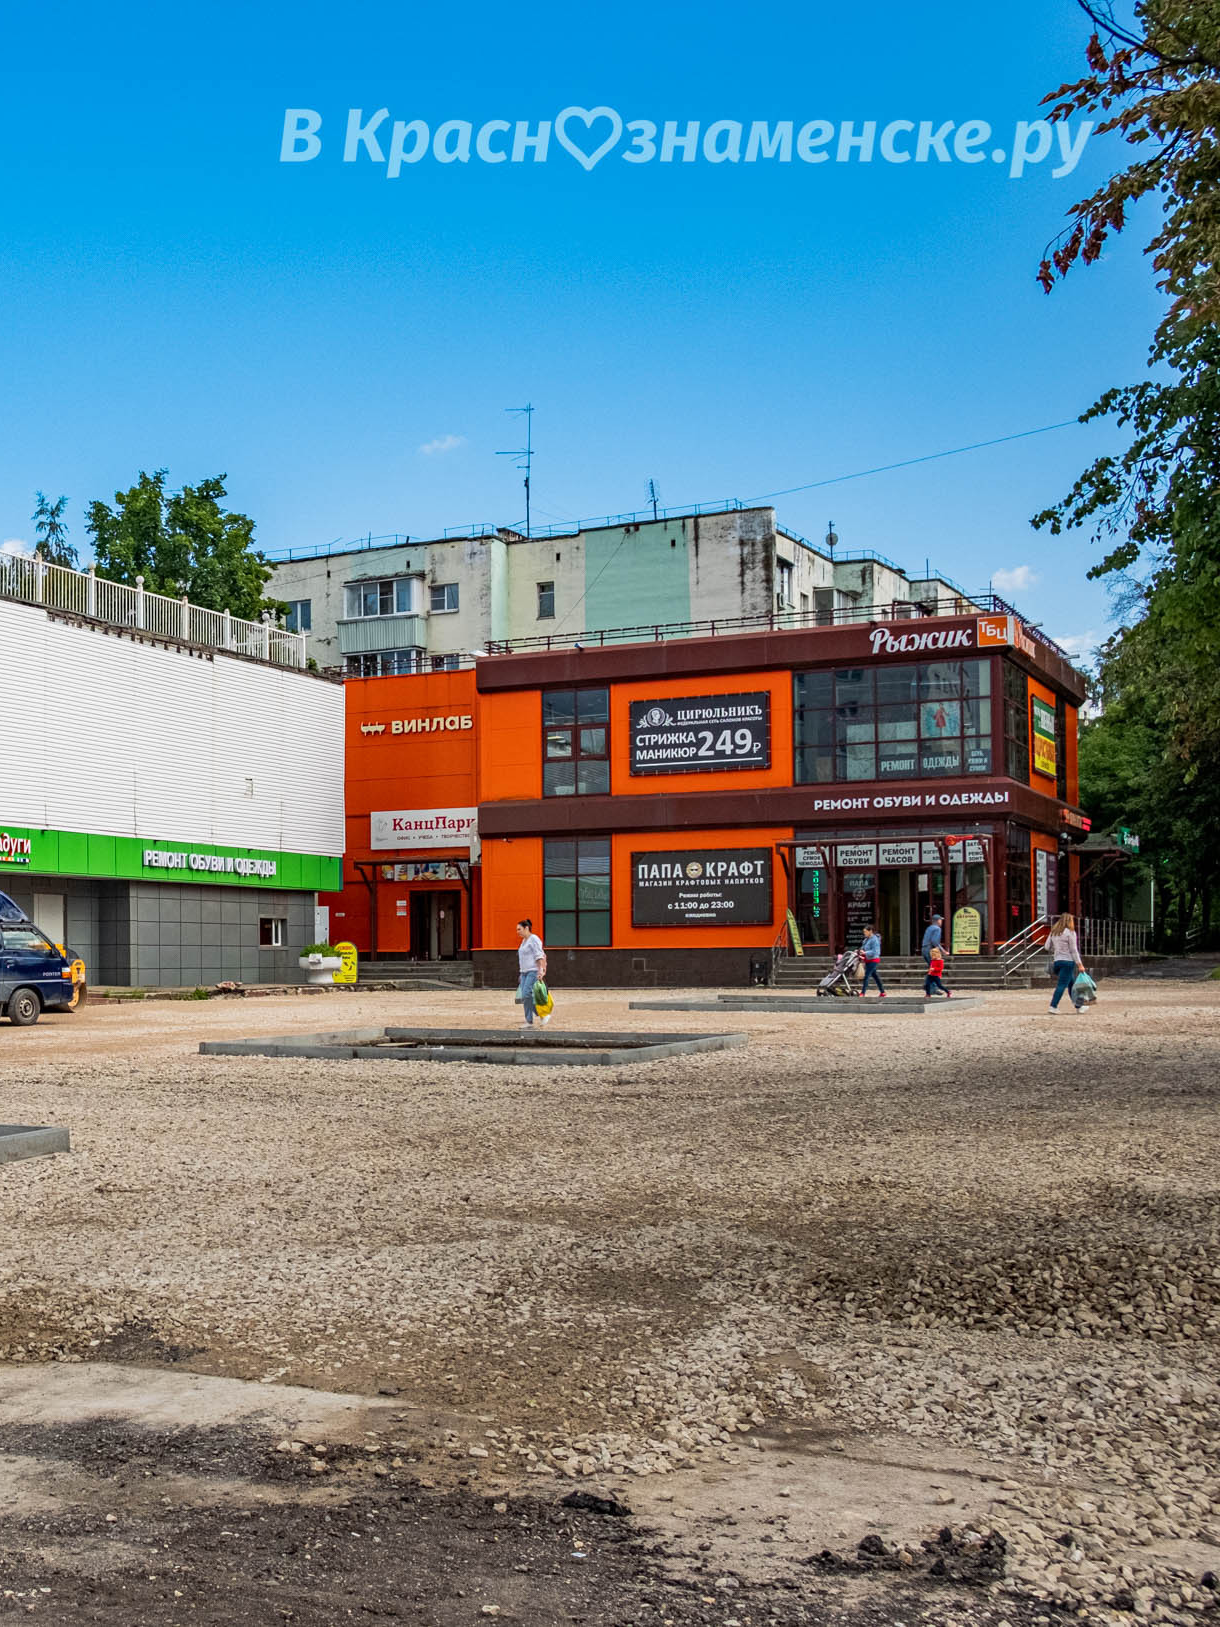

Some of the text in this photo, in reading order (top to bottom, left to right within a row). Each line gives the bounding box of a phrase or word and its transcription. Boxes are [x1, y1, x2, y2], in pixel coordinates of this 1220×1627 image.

[869, 628, 972, 654] Рыжик
[979, 621, 1008, 641] ТБЦ
[677, 705, 763, 720] ЦИРЮЛЬНИКЪ
[636, 732, 696, 746] СТРИЖКА
[636, 747, 697, 760] МАНИКЮР
[881, 759, 916, 772] РЕМОНТ
[923, 755, 960, 769] ОДЕЖДЫ
[814, 792, 1009, 810] РЕМОНТ ОБУВИ И ОДЕЖДЫ
[840, 849, 874, 857] РЕМОНТ
[885, 856, 913, 864] ЧАСОВ
[143, 849, 277, 877] РЕМОНТ ОБУВИ И ОДЕЖДЫ
[638, 860, 765, 879] ПАПА КРАФТ
[676, 878, 721, 886] КРАФТОВЫХ
[724, 877, 764, 885] НАПИТКОВ
[699, 902, 709, 910] до
[711, 901, 734, 909] 23:00
